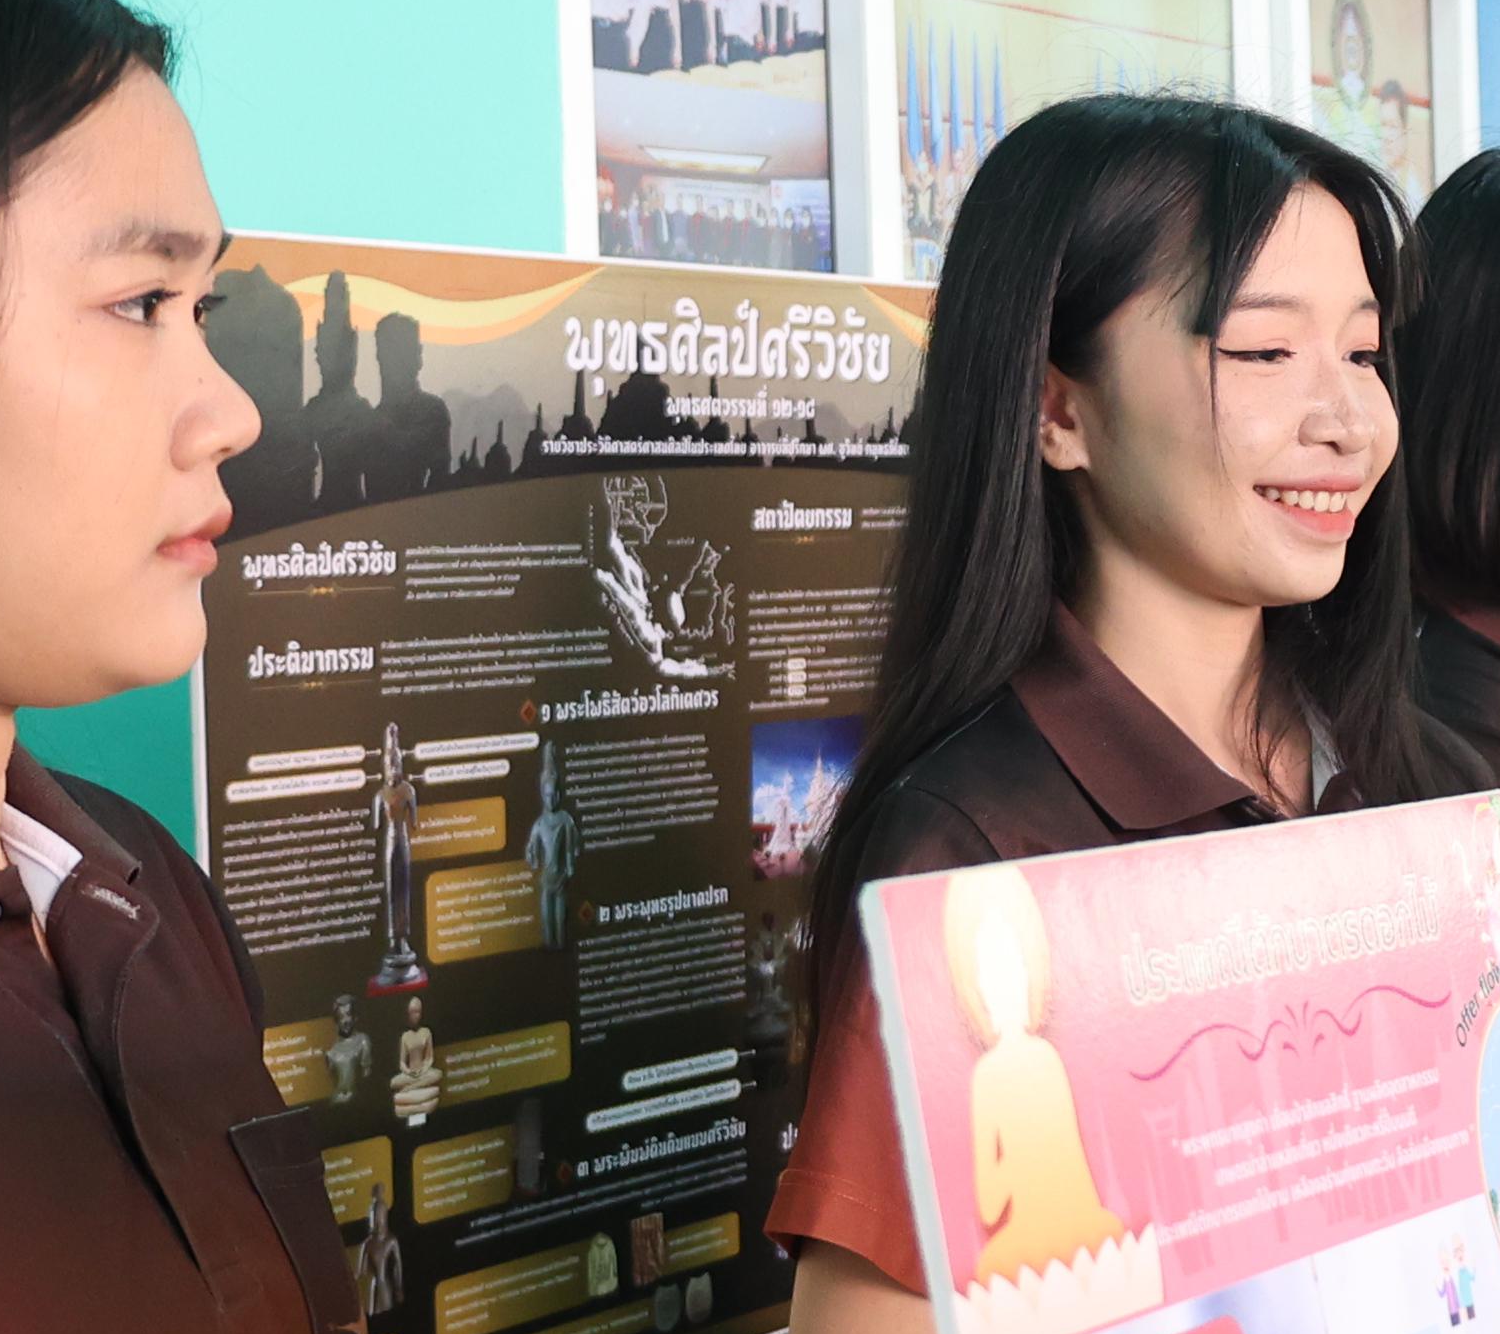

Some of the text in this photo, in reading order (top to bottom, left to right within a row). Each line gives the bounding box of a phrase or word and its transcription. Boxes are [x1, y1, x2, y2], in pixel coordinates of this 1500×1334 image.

[564, 297, 891, 396] พุทธศิลป์ศรีวิชัย
[665, 384, 767, 425] พุทธศตวรรษที่
[752, 499, 853, 533] สถาปัตยกรรม
[242, 539, 397, 589] พุทธศิลป์ศรีวิชัย
[248, 640, 374, 679] ประติมากรรม
[613, 884, 729, 929] พระพุทธรูปนาคปรก
[1455, 992, 1481, 1047] Offer
